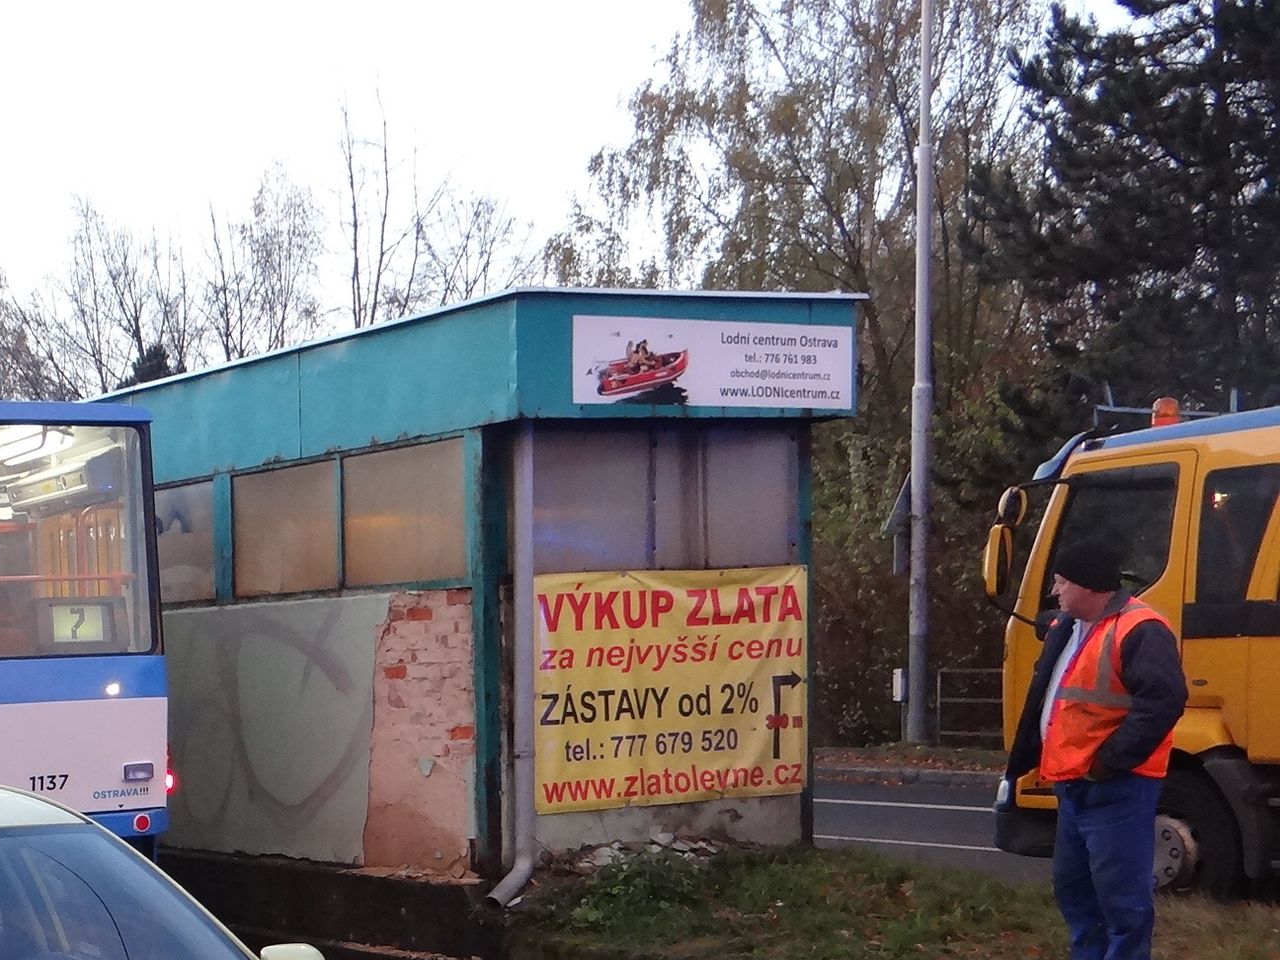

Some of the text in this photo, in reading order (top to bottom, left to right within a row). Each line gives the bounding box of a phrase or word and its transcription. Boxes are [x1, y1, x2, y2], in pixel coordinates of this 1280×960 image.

[721, 332, 838, 349] Lodní centrum Ostrava
[745, 352, 818, 365] tel.: 776 761 983
[720, 386, 841, 400] www.LODNIcentrum.cz
[69, 608, 85, 639] 7
[538, 583, 803, 633] VÝKUP ZLATA
[539, 634, 803, 674] za nejvyšší cenu
[540, 681, 759, 726] ZÁSTAVY od 2%
[565, 728, 738, 762] tel.: 777 679 520
[29, 774, 69, 791] 1137
[93, 787, 149, 799] OSTRAVA!!!
[543, 763, 803, 804] www.zlatolevne.cz
